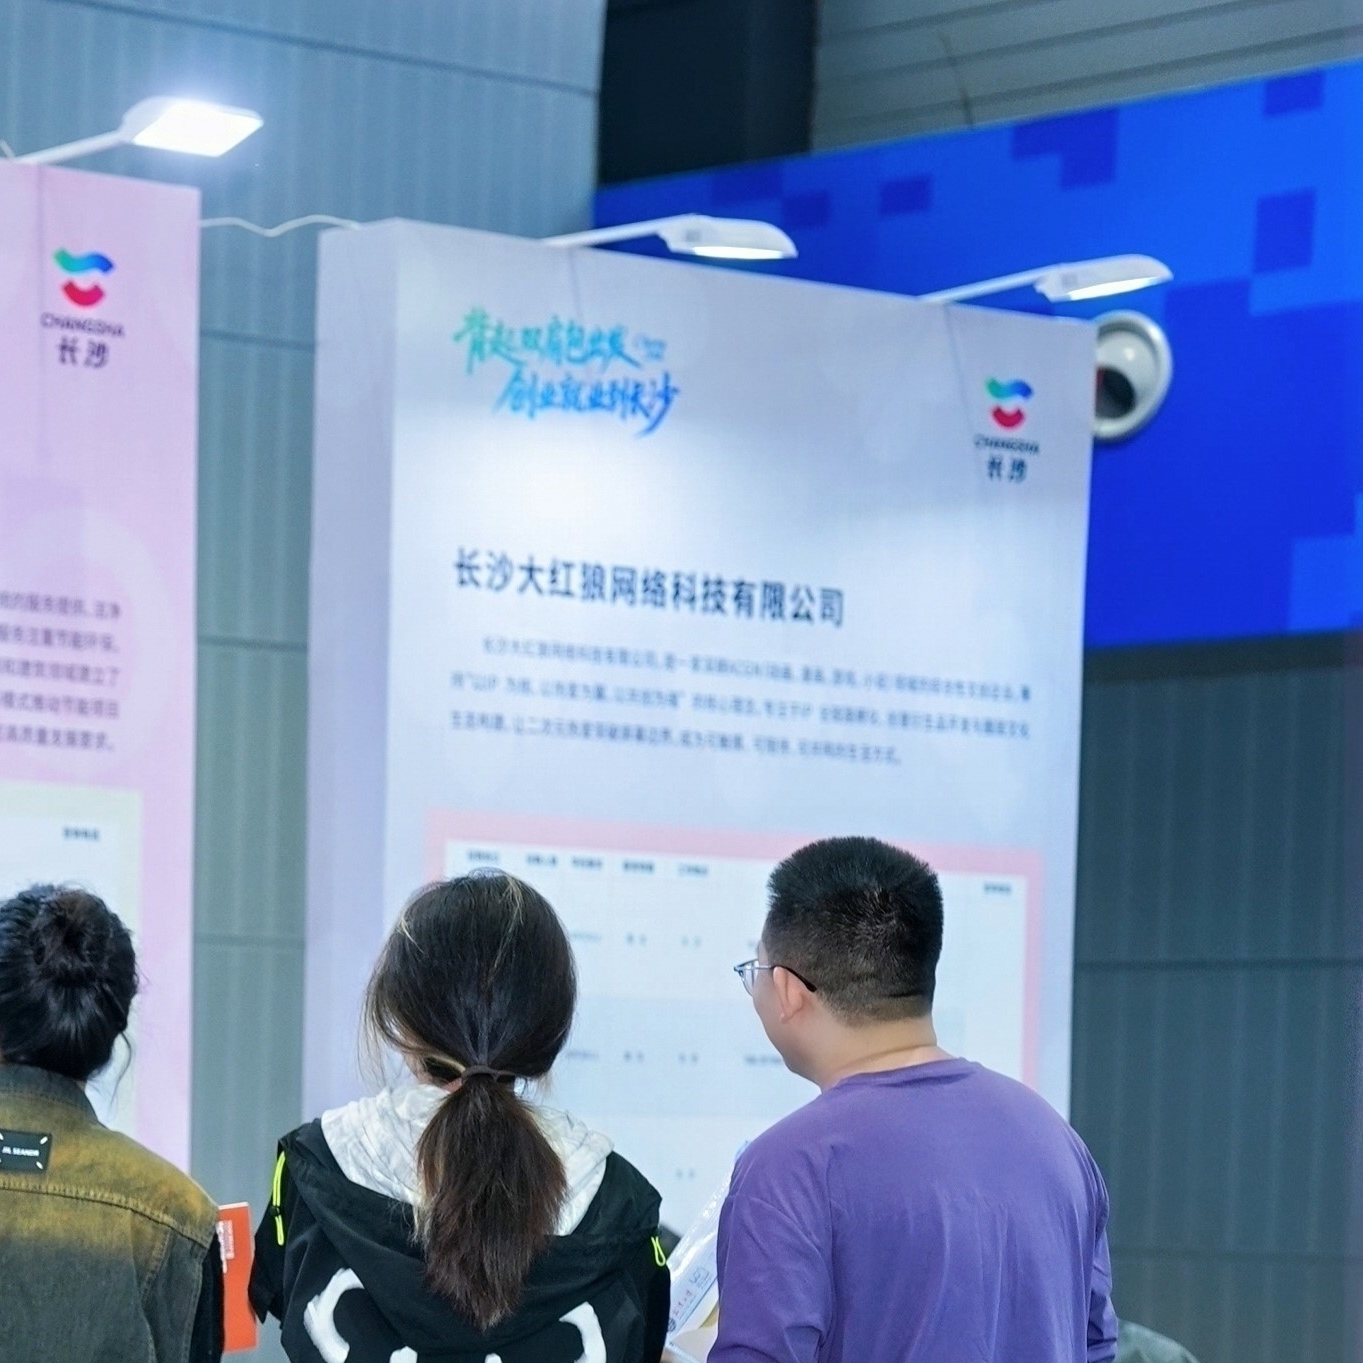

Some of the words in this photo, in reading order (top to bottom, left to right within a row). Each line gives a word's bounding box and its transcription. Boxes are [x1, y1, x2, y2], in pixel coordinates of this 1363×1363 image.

[453, 547, 845, 627] 长沙大红狼网络科技有限公司
